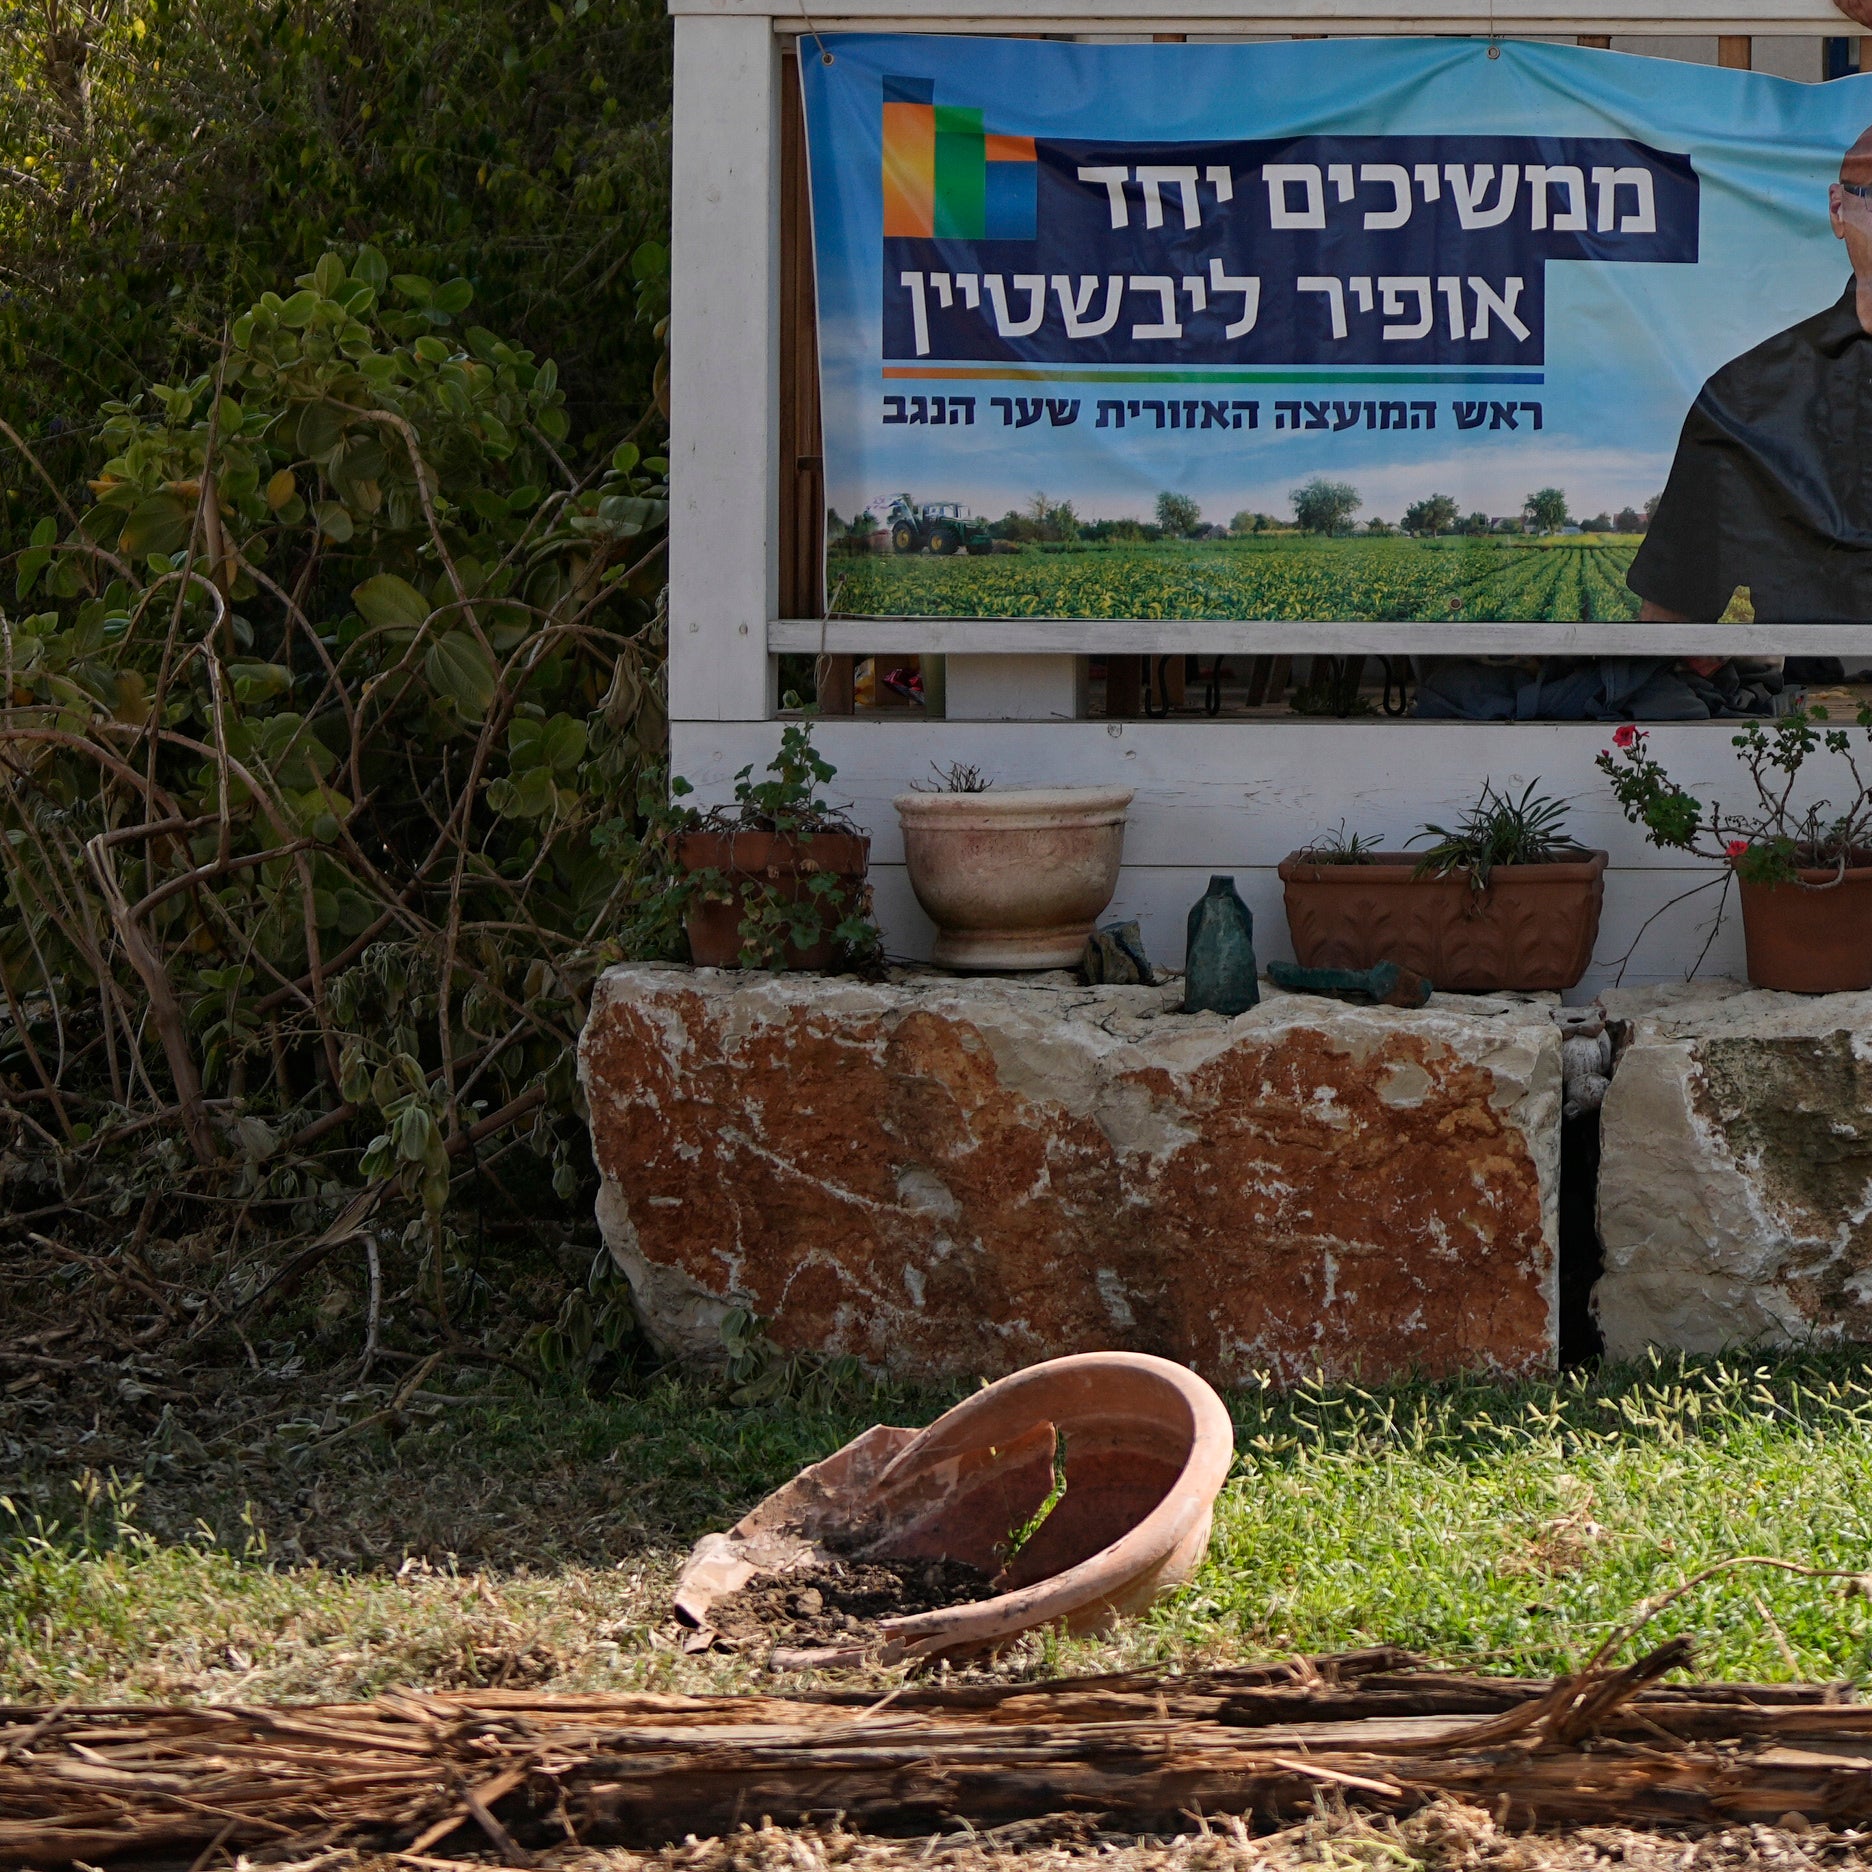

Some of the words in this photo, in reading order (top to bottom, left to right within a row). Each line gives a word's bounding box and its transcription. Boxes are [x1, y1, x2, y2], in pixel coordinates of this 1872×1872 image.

[1077, 165, 1234, 230] יחד
[1261, 163, 1657, 234] ממשיכים
[900, 257, 1261, 357] ליבשטיין
[1296, 275, 1532, 343] אופיר
[882, 394, 976, 426] הנגב
[990, 396, 1081, 429] שער
[1095, 398, 1260, 430] האזורית
[1274, 399, 1437, 432] המועצה
[1452, 400, 1543, 431] ראש
